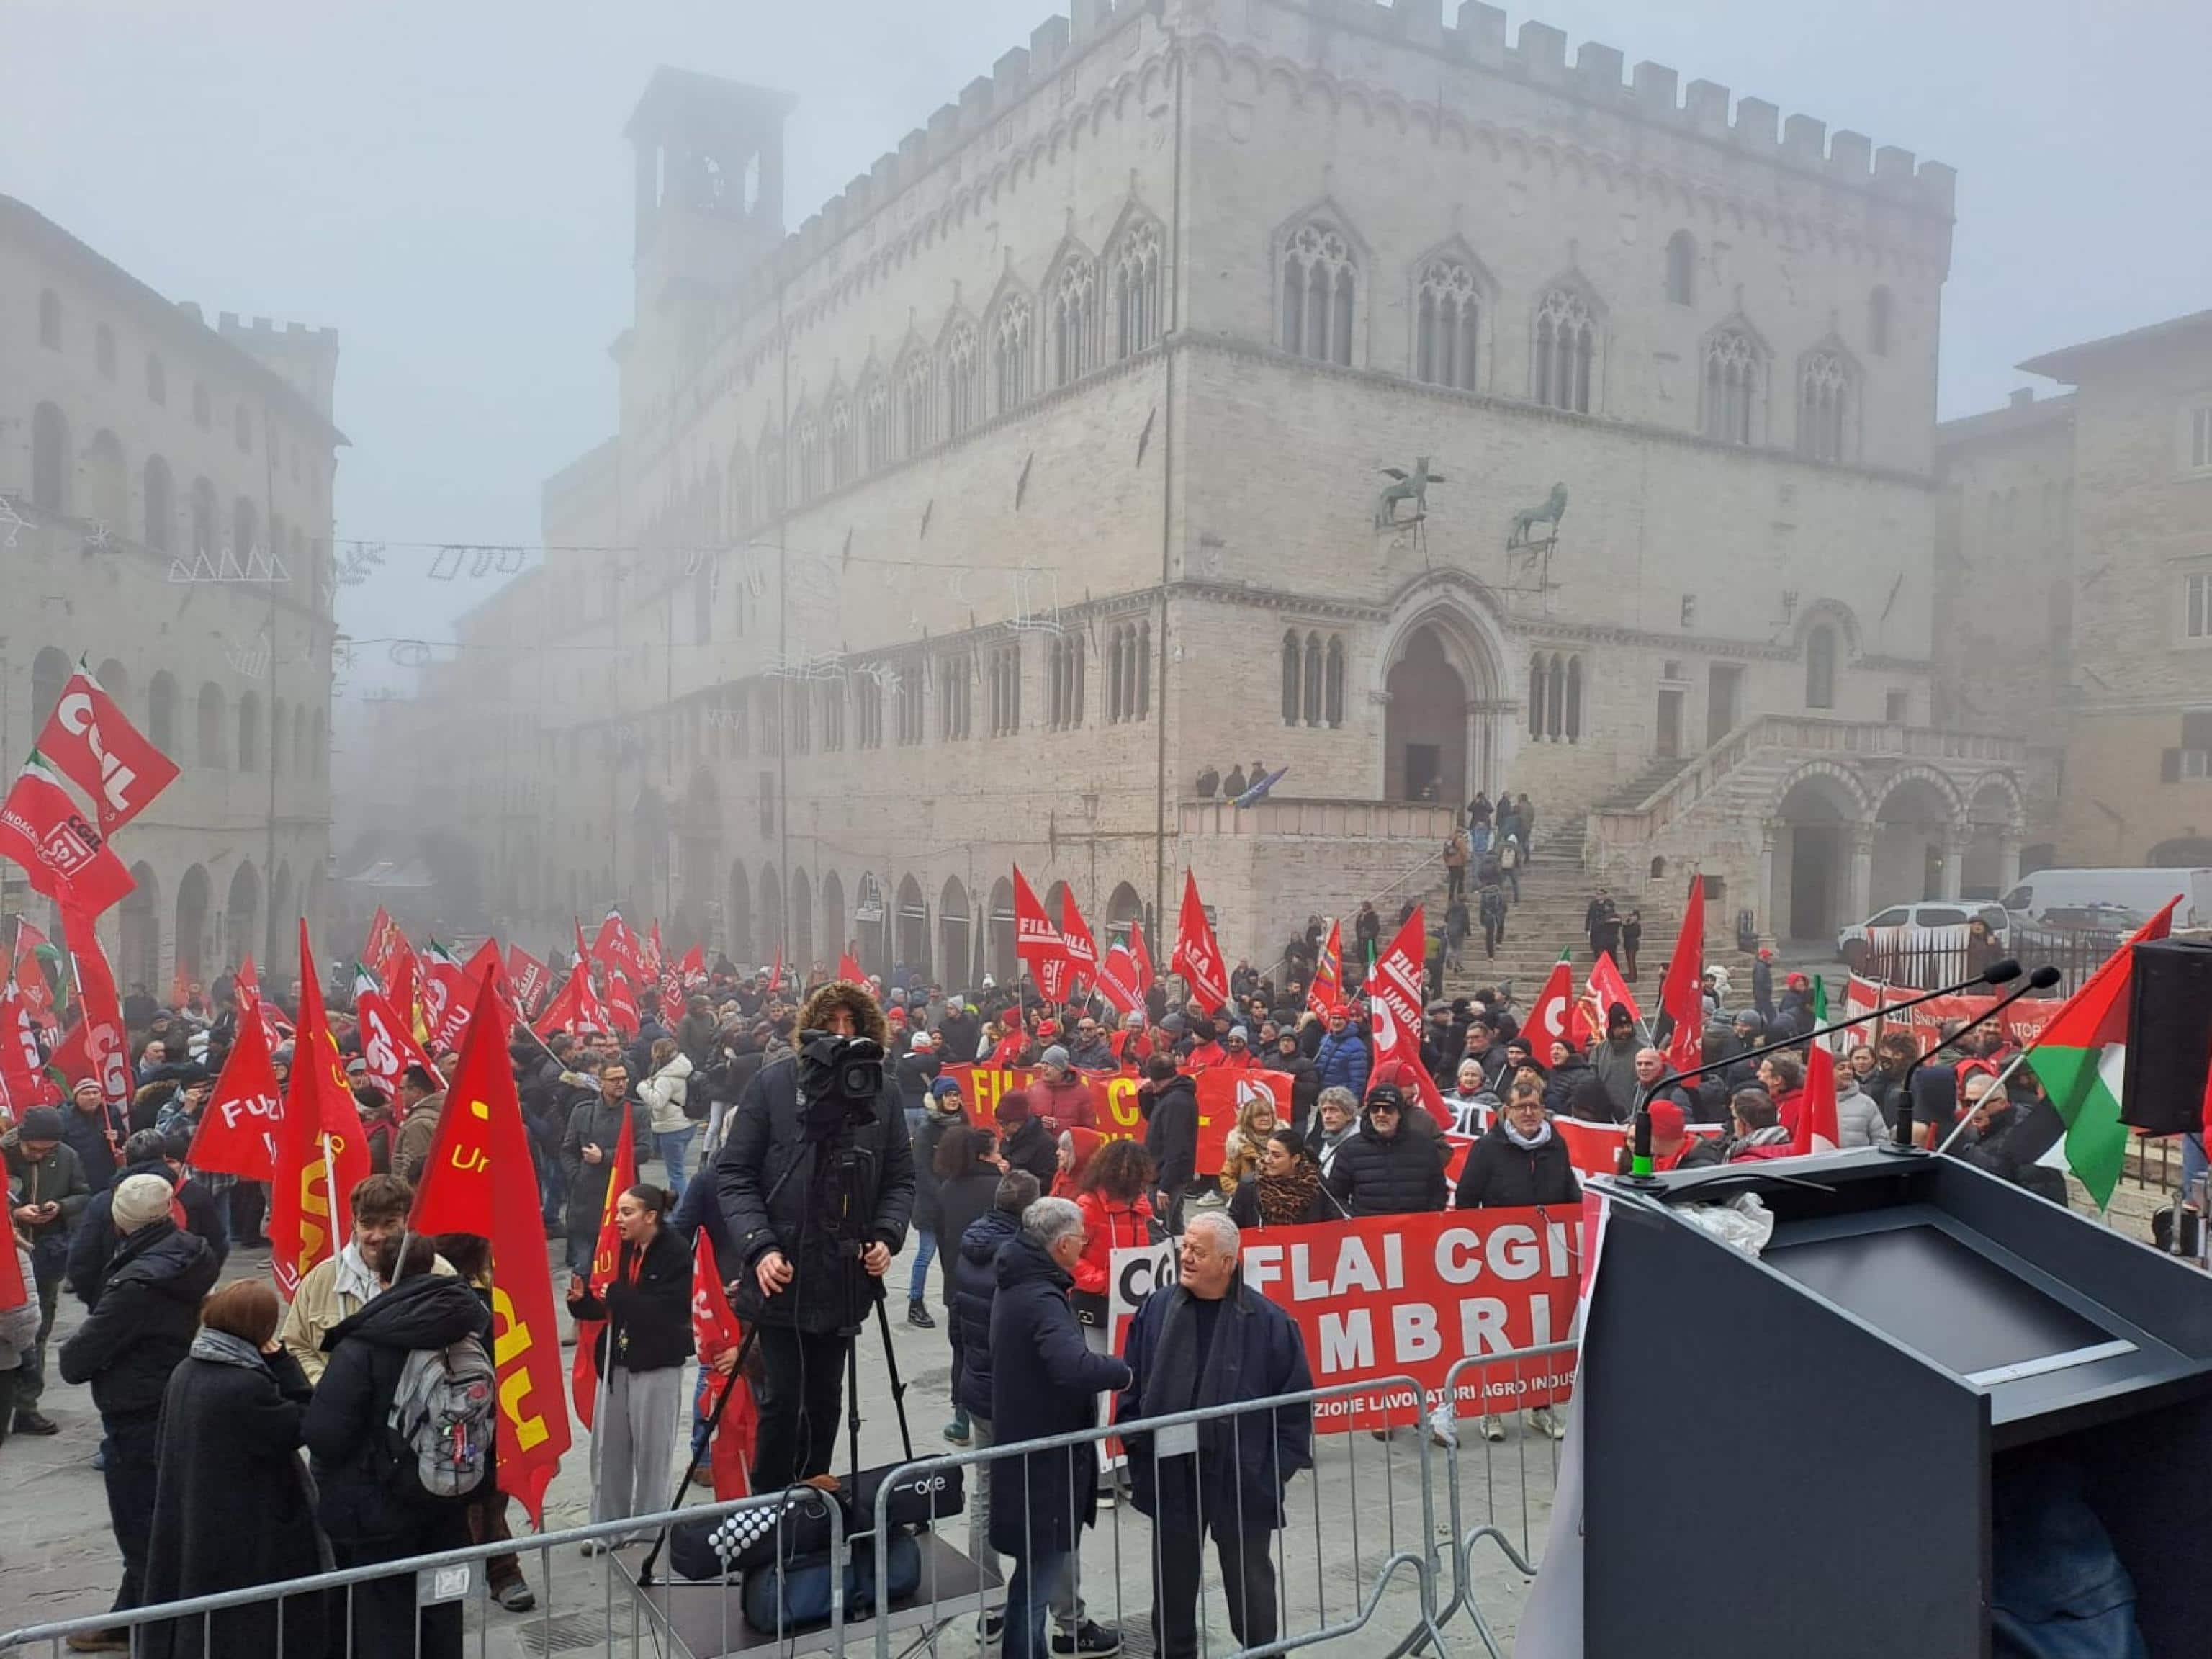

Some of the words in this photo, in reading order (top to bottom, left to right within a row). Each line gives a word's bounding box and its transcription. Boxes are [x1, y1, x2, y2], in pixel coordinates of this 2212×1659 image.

[1382, 985, 1422, 1040] UMBR
[1244, 1232, 1404, 1302] FLAI
[1318, 1293, 1583, 1374] MBRI
[1481, 1380, 1527, 1398] AGRO
[1532, 1370, 1575, 1391] INDUS
